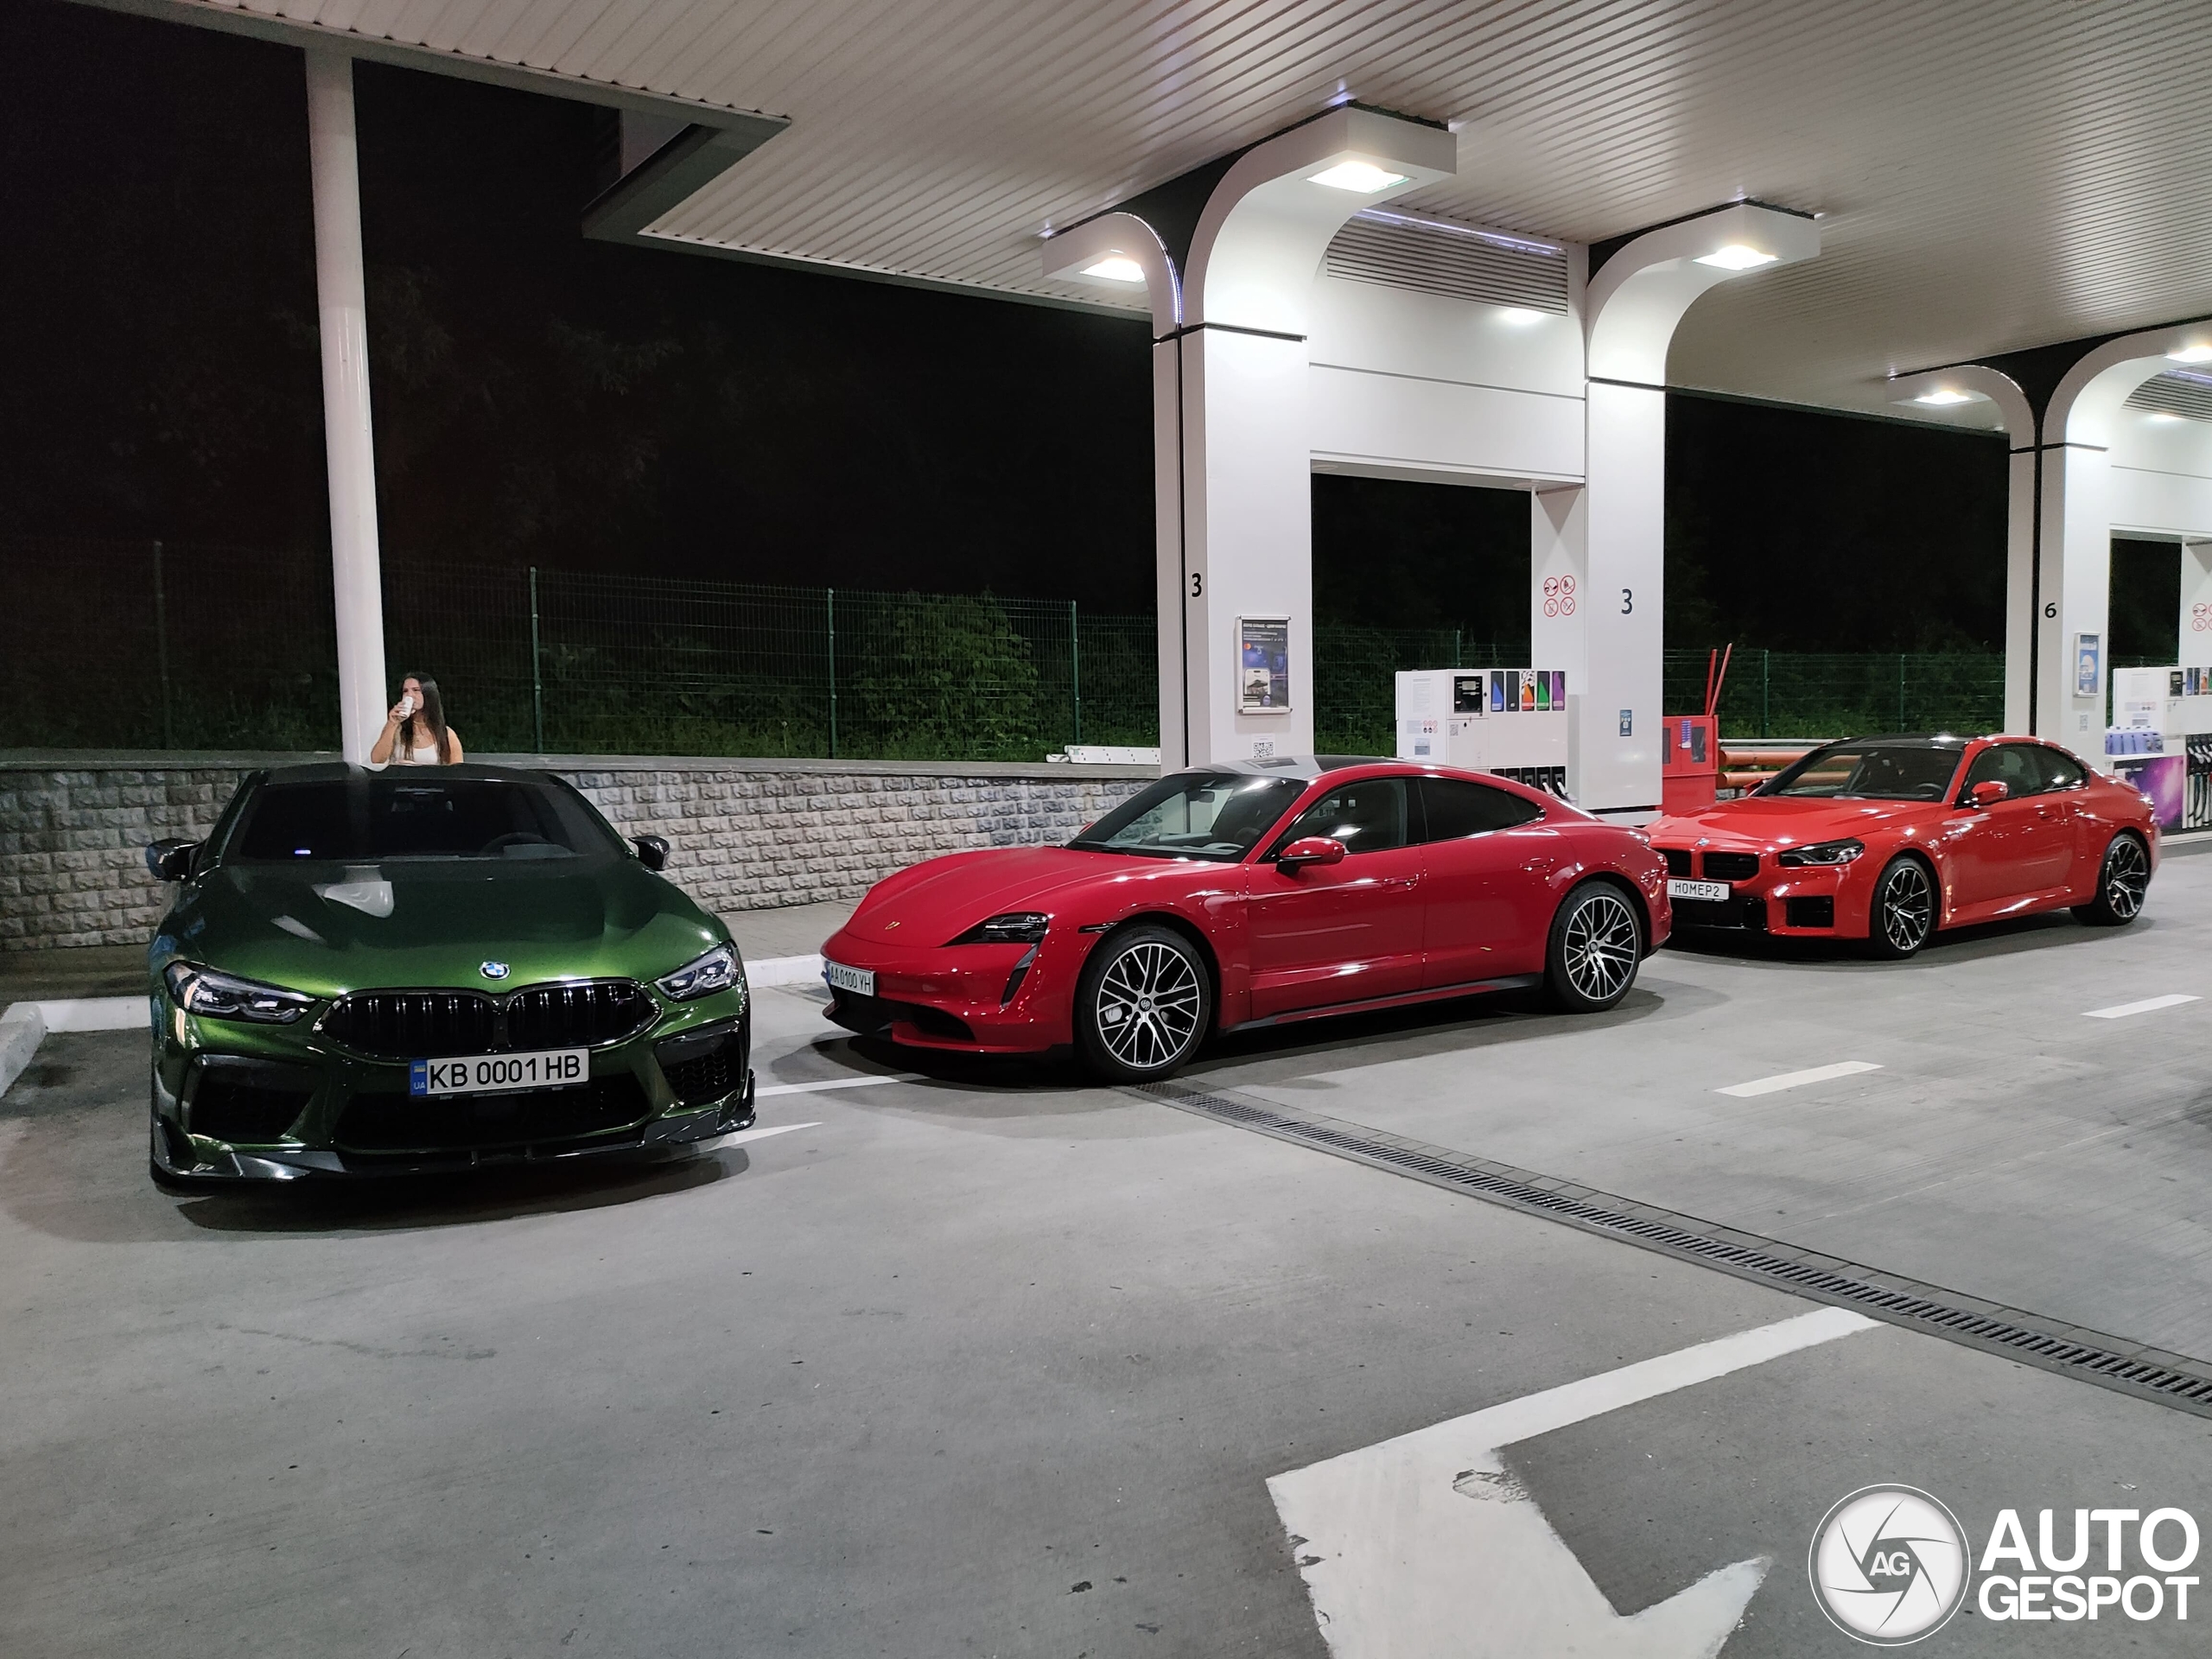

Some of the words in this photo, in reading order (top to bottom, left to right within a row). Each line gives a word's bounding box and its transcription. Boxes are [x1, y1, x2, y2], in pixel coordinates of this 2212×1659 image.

[1192, 572, 1202, 597] 3
[1621, 588, 1632, 614] 3
[2044, 602, 2056, 618] 6
[1675, 882, 1719, 897] HOMEP2
[830, 966, 839, 982] AA
[840, 969, 857, 988] 0100
[859, 974, 871, 992] YH
[430, 1063, 467, 1089] KB
[477, 1058, 536, 1084] 0001
[546, 1055, 580, 1080] HB
